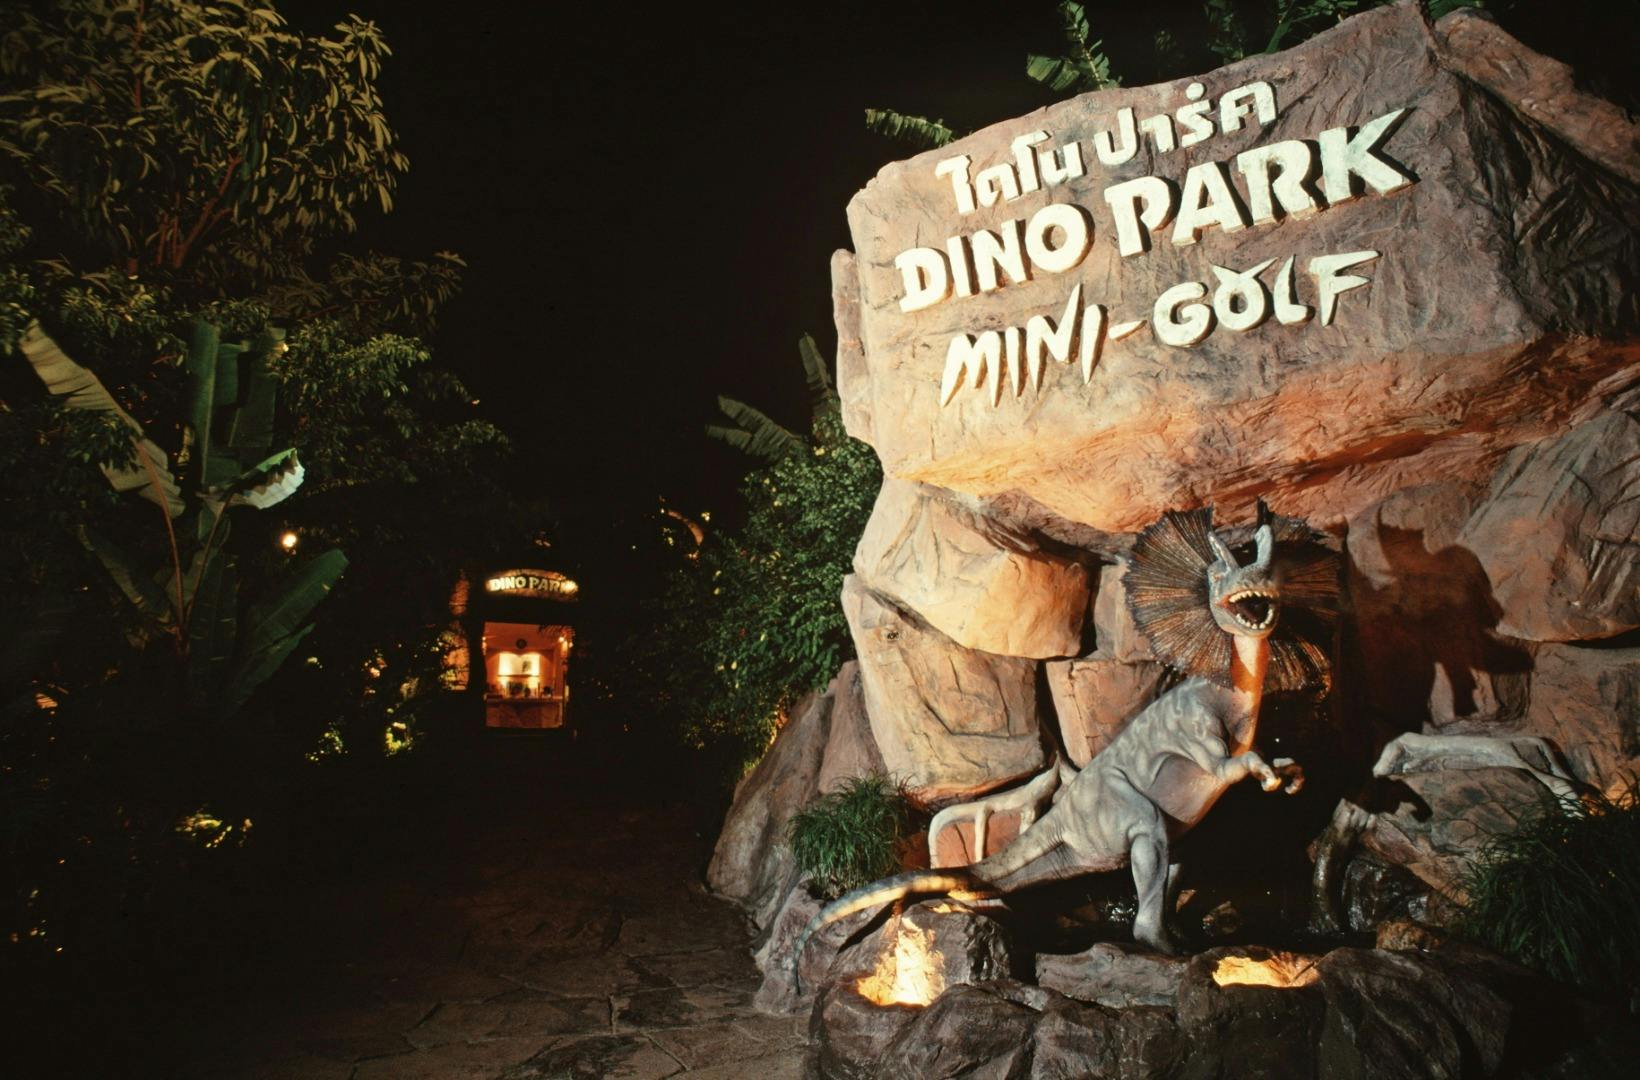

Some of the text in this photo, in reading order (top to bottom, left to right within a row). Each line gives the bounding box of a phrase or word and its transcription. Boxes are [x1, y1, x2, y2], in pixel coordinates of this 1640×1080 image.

[894, 109, 1410, 313] DINO PARK
[940, 250, 1379, 408] MINI-GOLF
[489, 576, 527, 591] DINO
